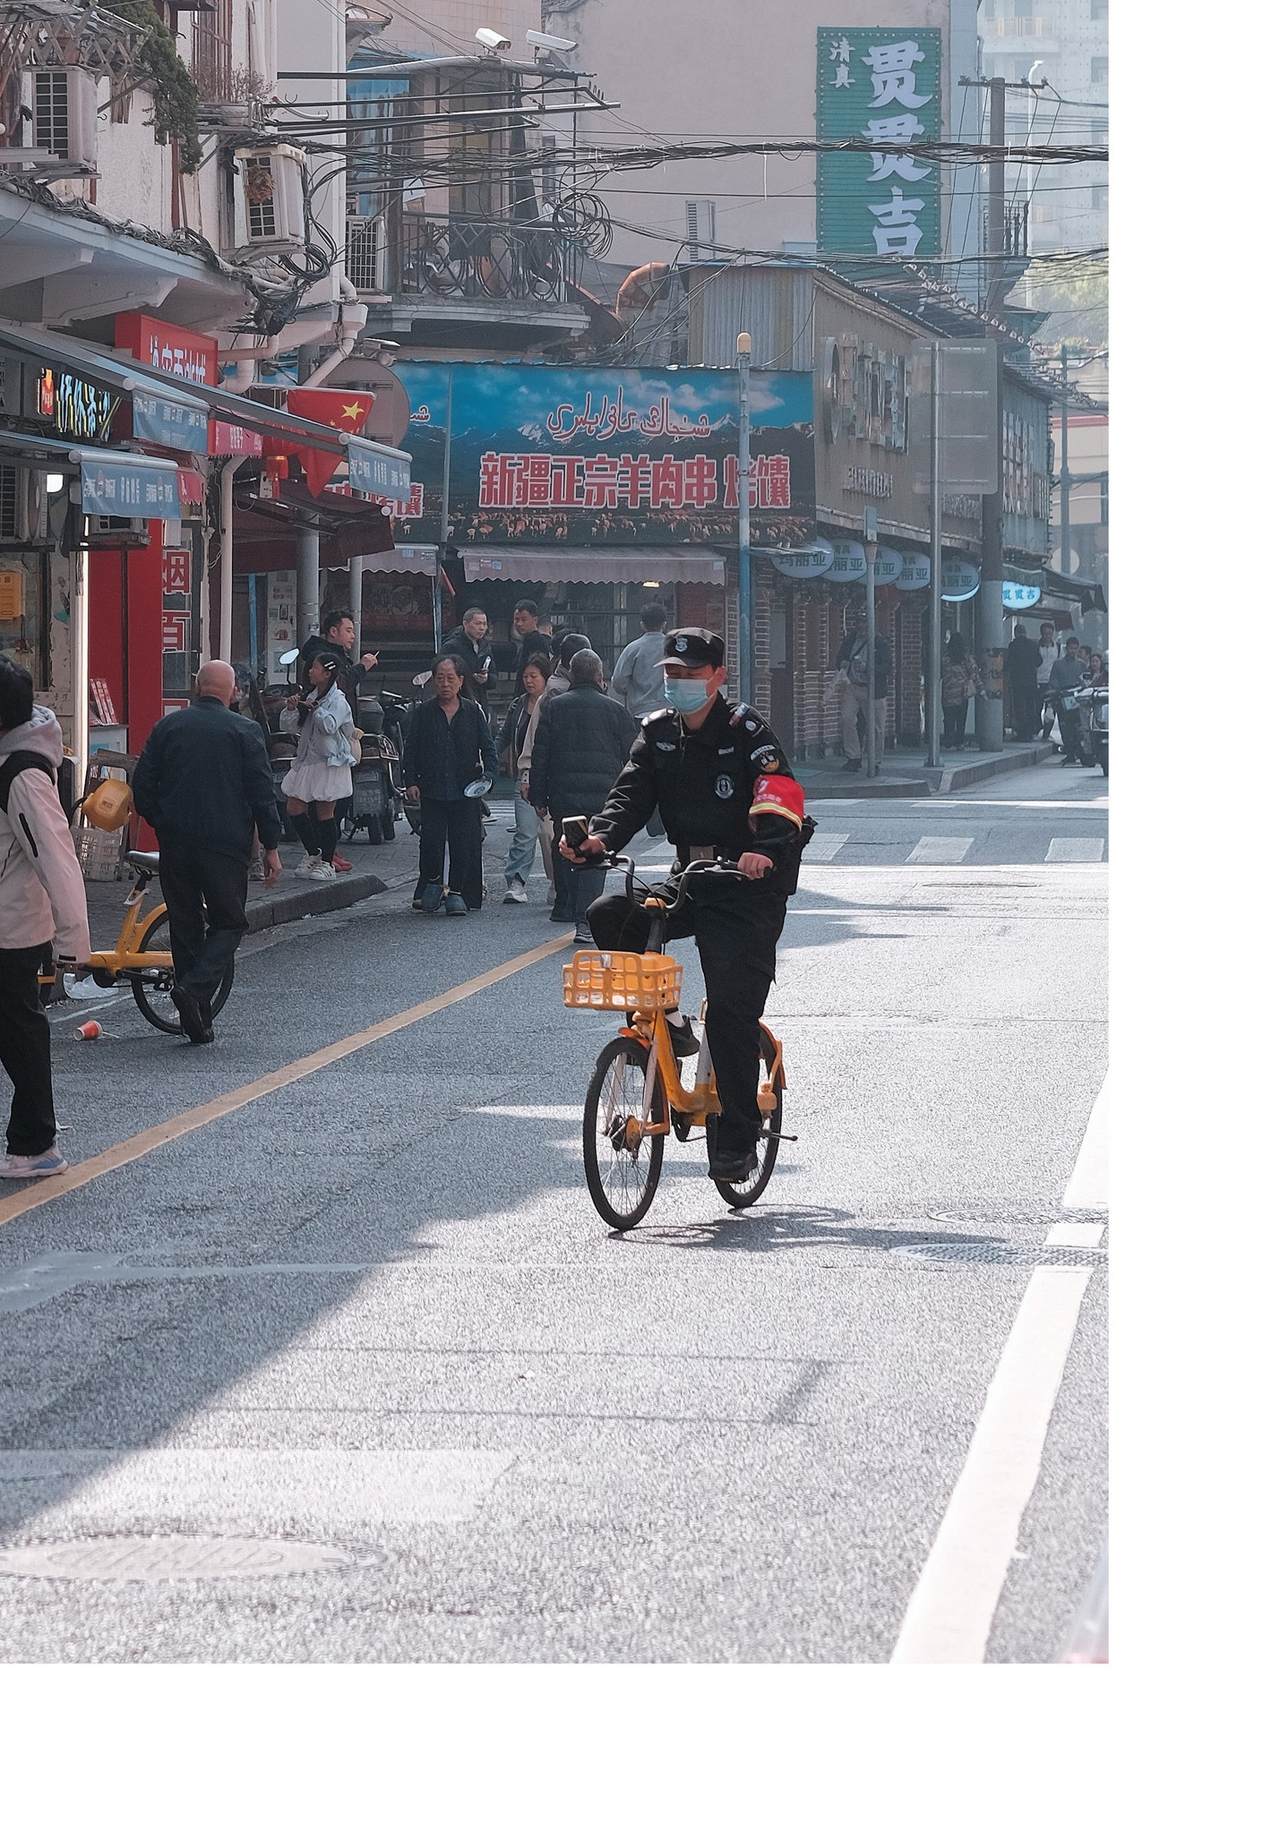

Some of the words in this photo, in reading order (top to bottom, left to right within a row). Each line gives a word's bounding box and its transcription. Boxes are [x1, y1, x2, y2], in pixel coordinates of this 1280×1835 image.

[829, 37, 855, 89] 清真
[861, 40, 933, 256] 贯贯吉
[479, 452, 717, 509] 新疆正宗羊肉串
[830, 557, 864, 571] 丽亚
[896, 567, 928, 581] 丽亚
